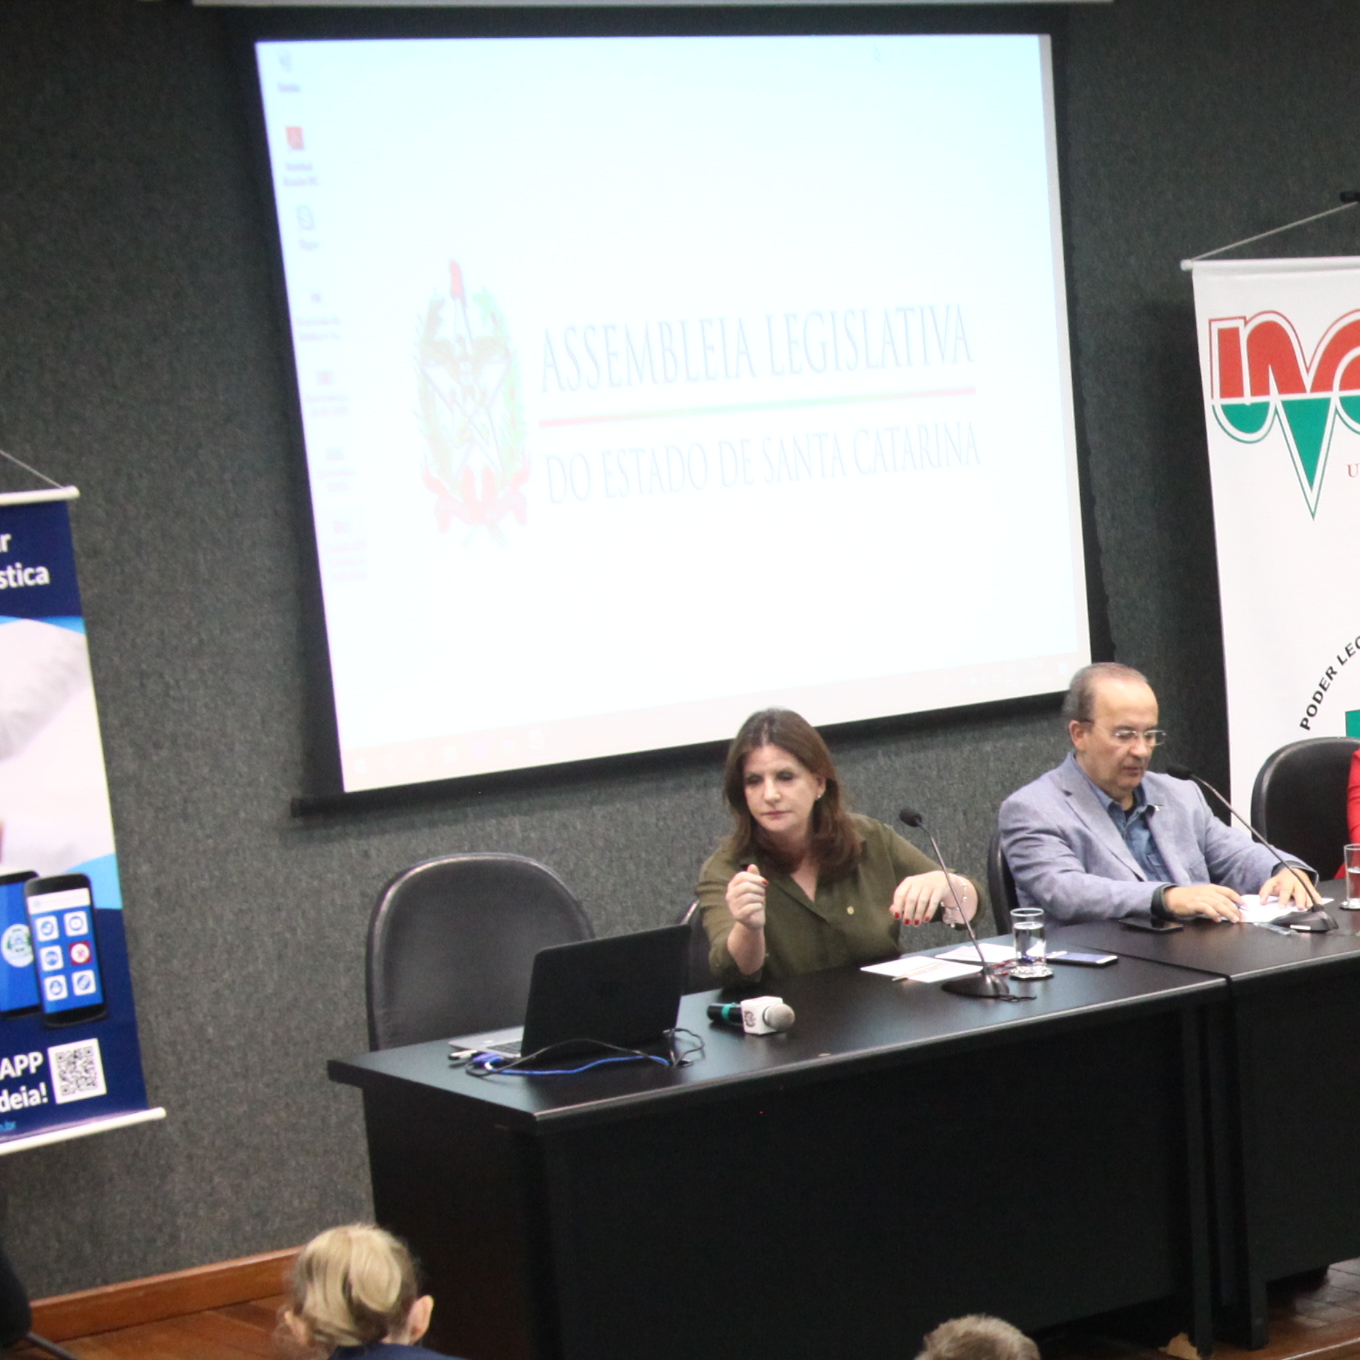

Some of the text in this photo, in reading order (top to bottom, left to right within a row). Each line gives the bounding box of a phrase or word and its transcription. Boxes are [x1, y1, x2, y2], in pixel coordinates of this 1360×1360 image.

[541, 304, 975, 392] ASSEMBLEIA LEGISLATIVA
[546, 421, 981, 504] DO ESTADO DE SANTA CATARINA
[1300, 666, 1338, 731] PODER
[0, 1051, 44, 1081] APP
